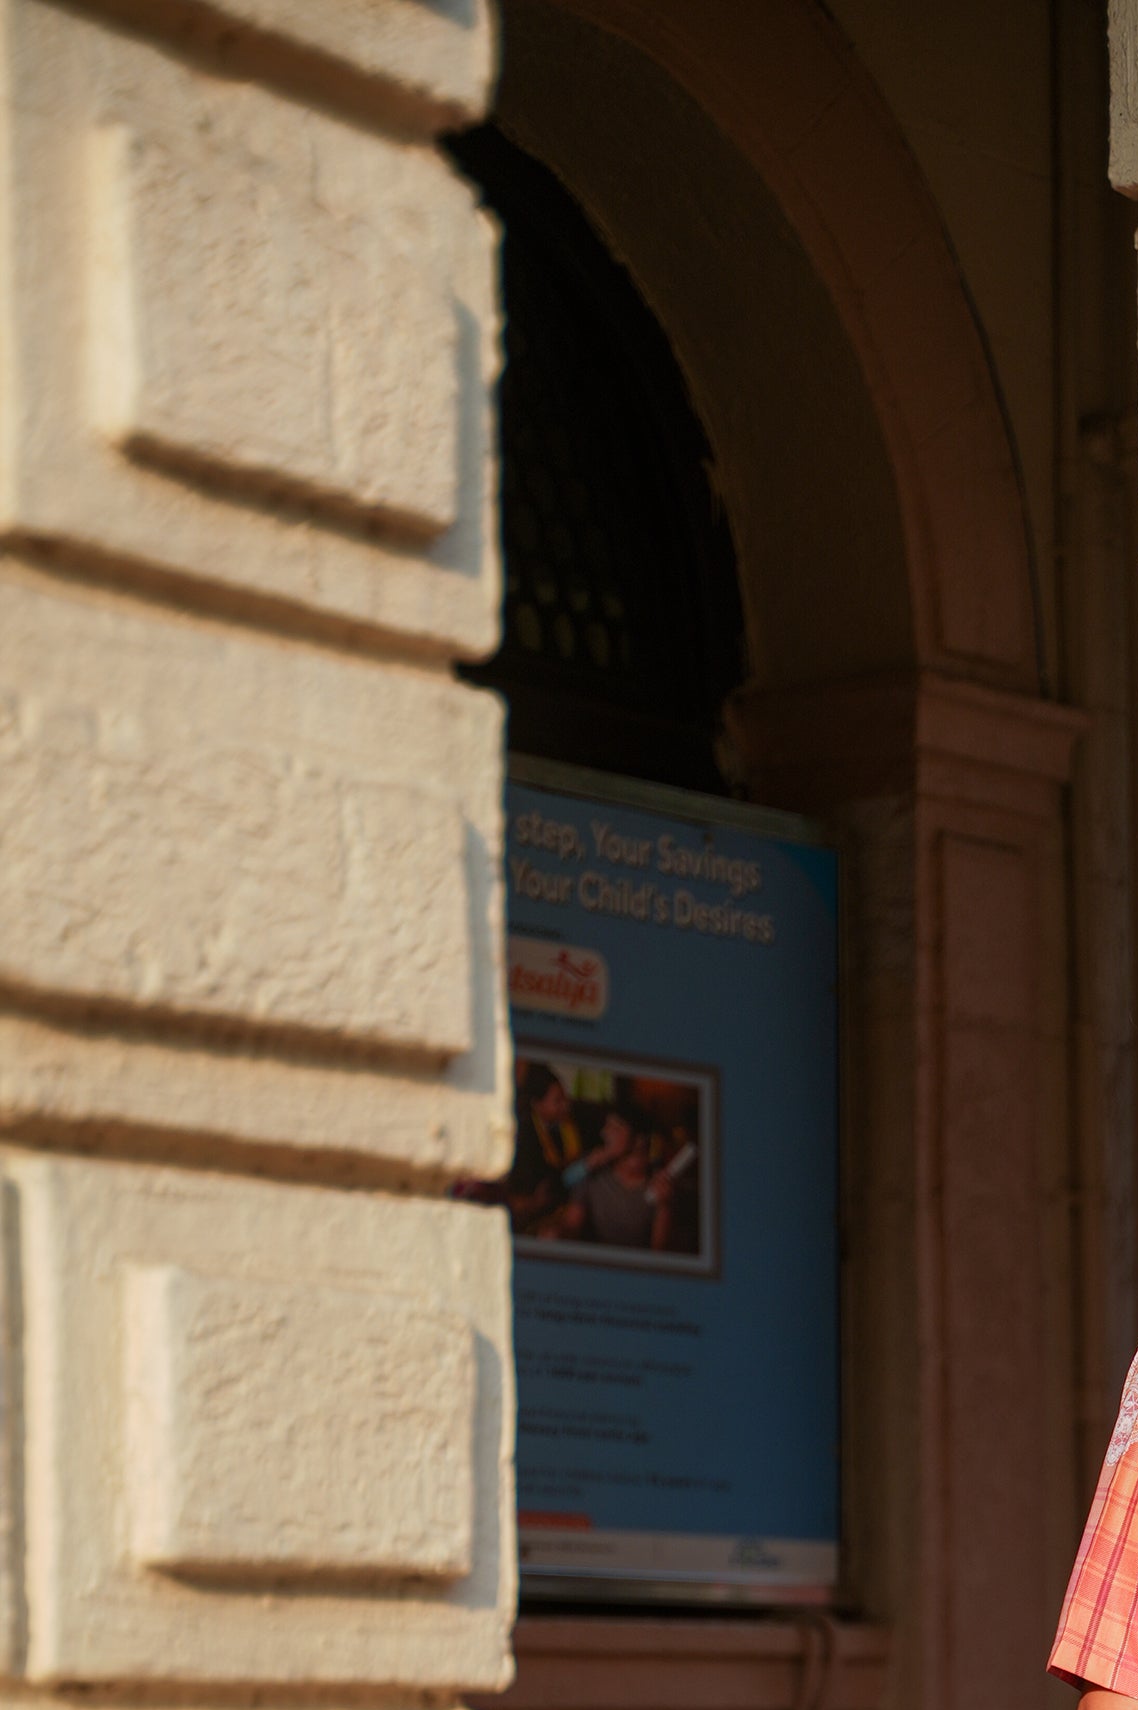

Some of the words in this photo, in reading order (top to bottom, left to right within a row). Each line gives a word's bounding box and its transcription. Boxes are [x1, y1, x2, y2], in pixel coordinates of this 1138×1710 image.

[590, 819, 651, 866] Your
[658, 834, 762, 898] Savings
[509, 857, 573, 904] Your
[578, 870, 668, 924] Child's
[673, 889, 776, 946] Desires
[508, 963, 599, 1008] tsalya
